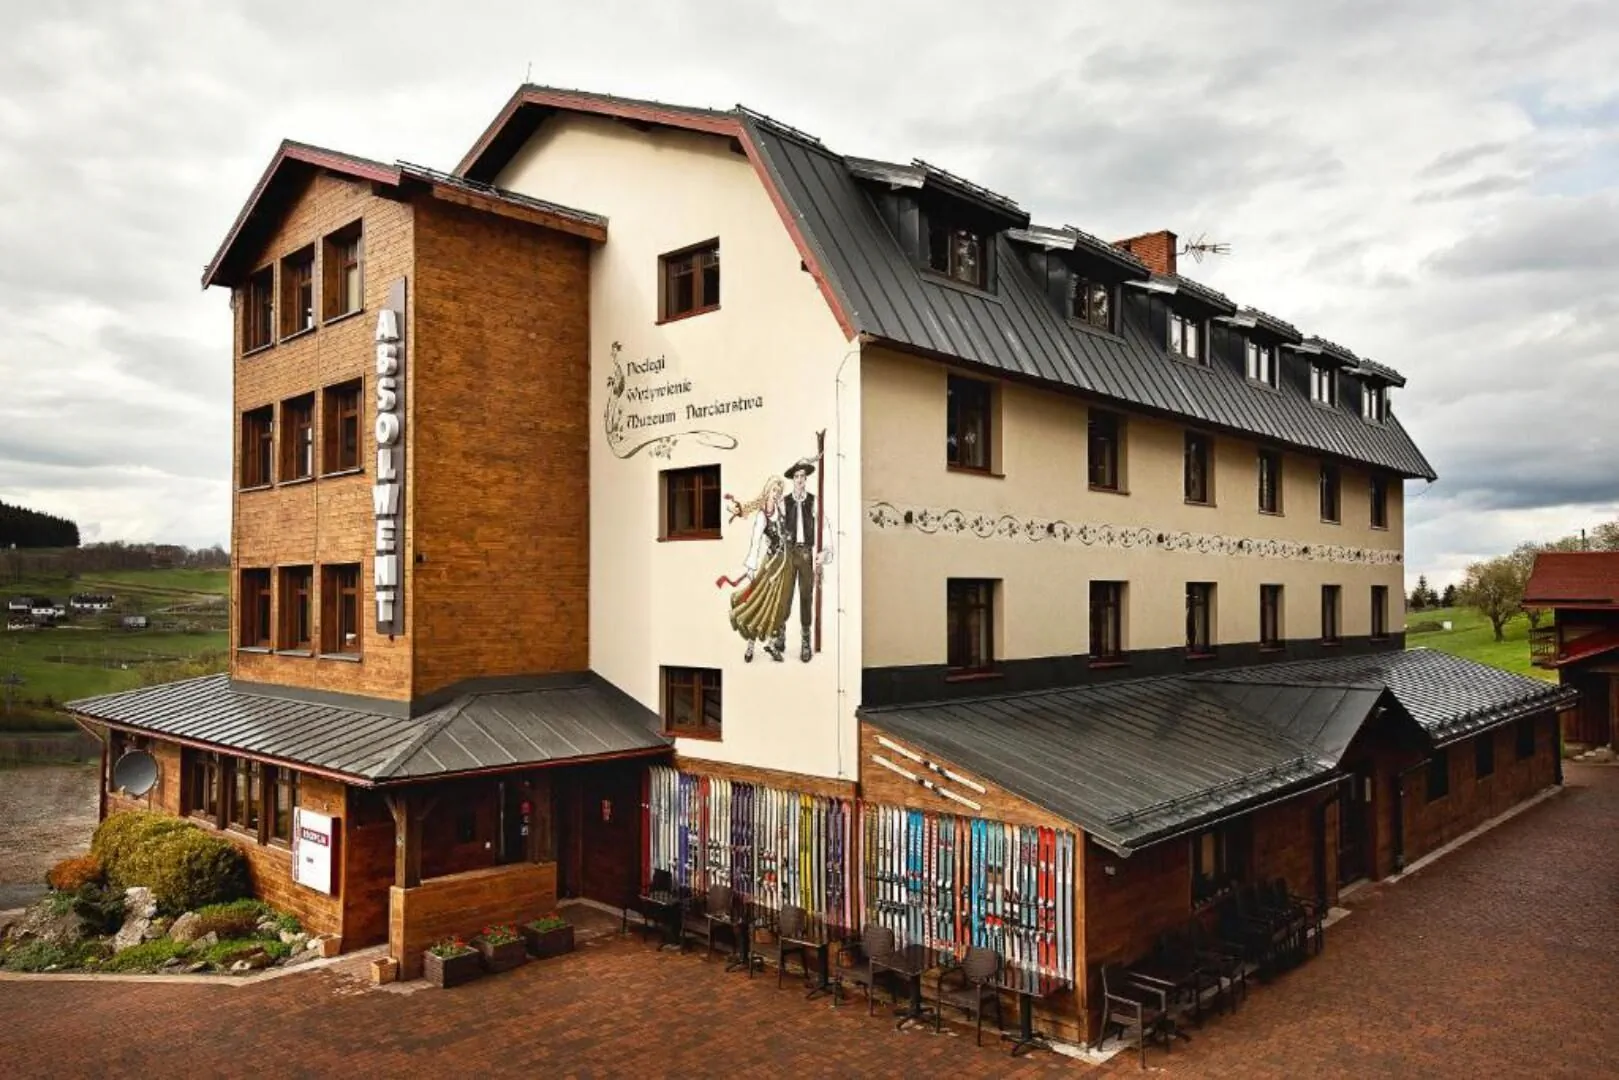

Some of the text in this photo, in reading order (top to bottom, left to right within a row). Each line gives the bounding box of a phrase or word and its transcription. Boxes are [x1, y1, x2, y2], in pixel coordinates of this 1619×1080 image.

[627, 354, 665, 376] Noclegi
[626, 396, 763, 430] Muzeum Narciarstwa
